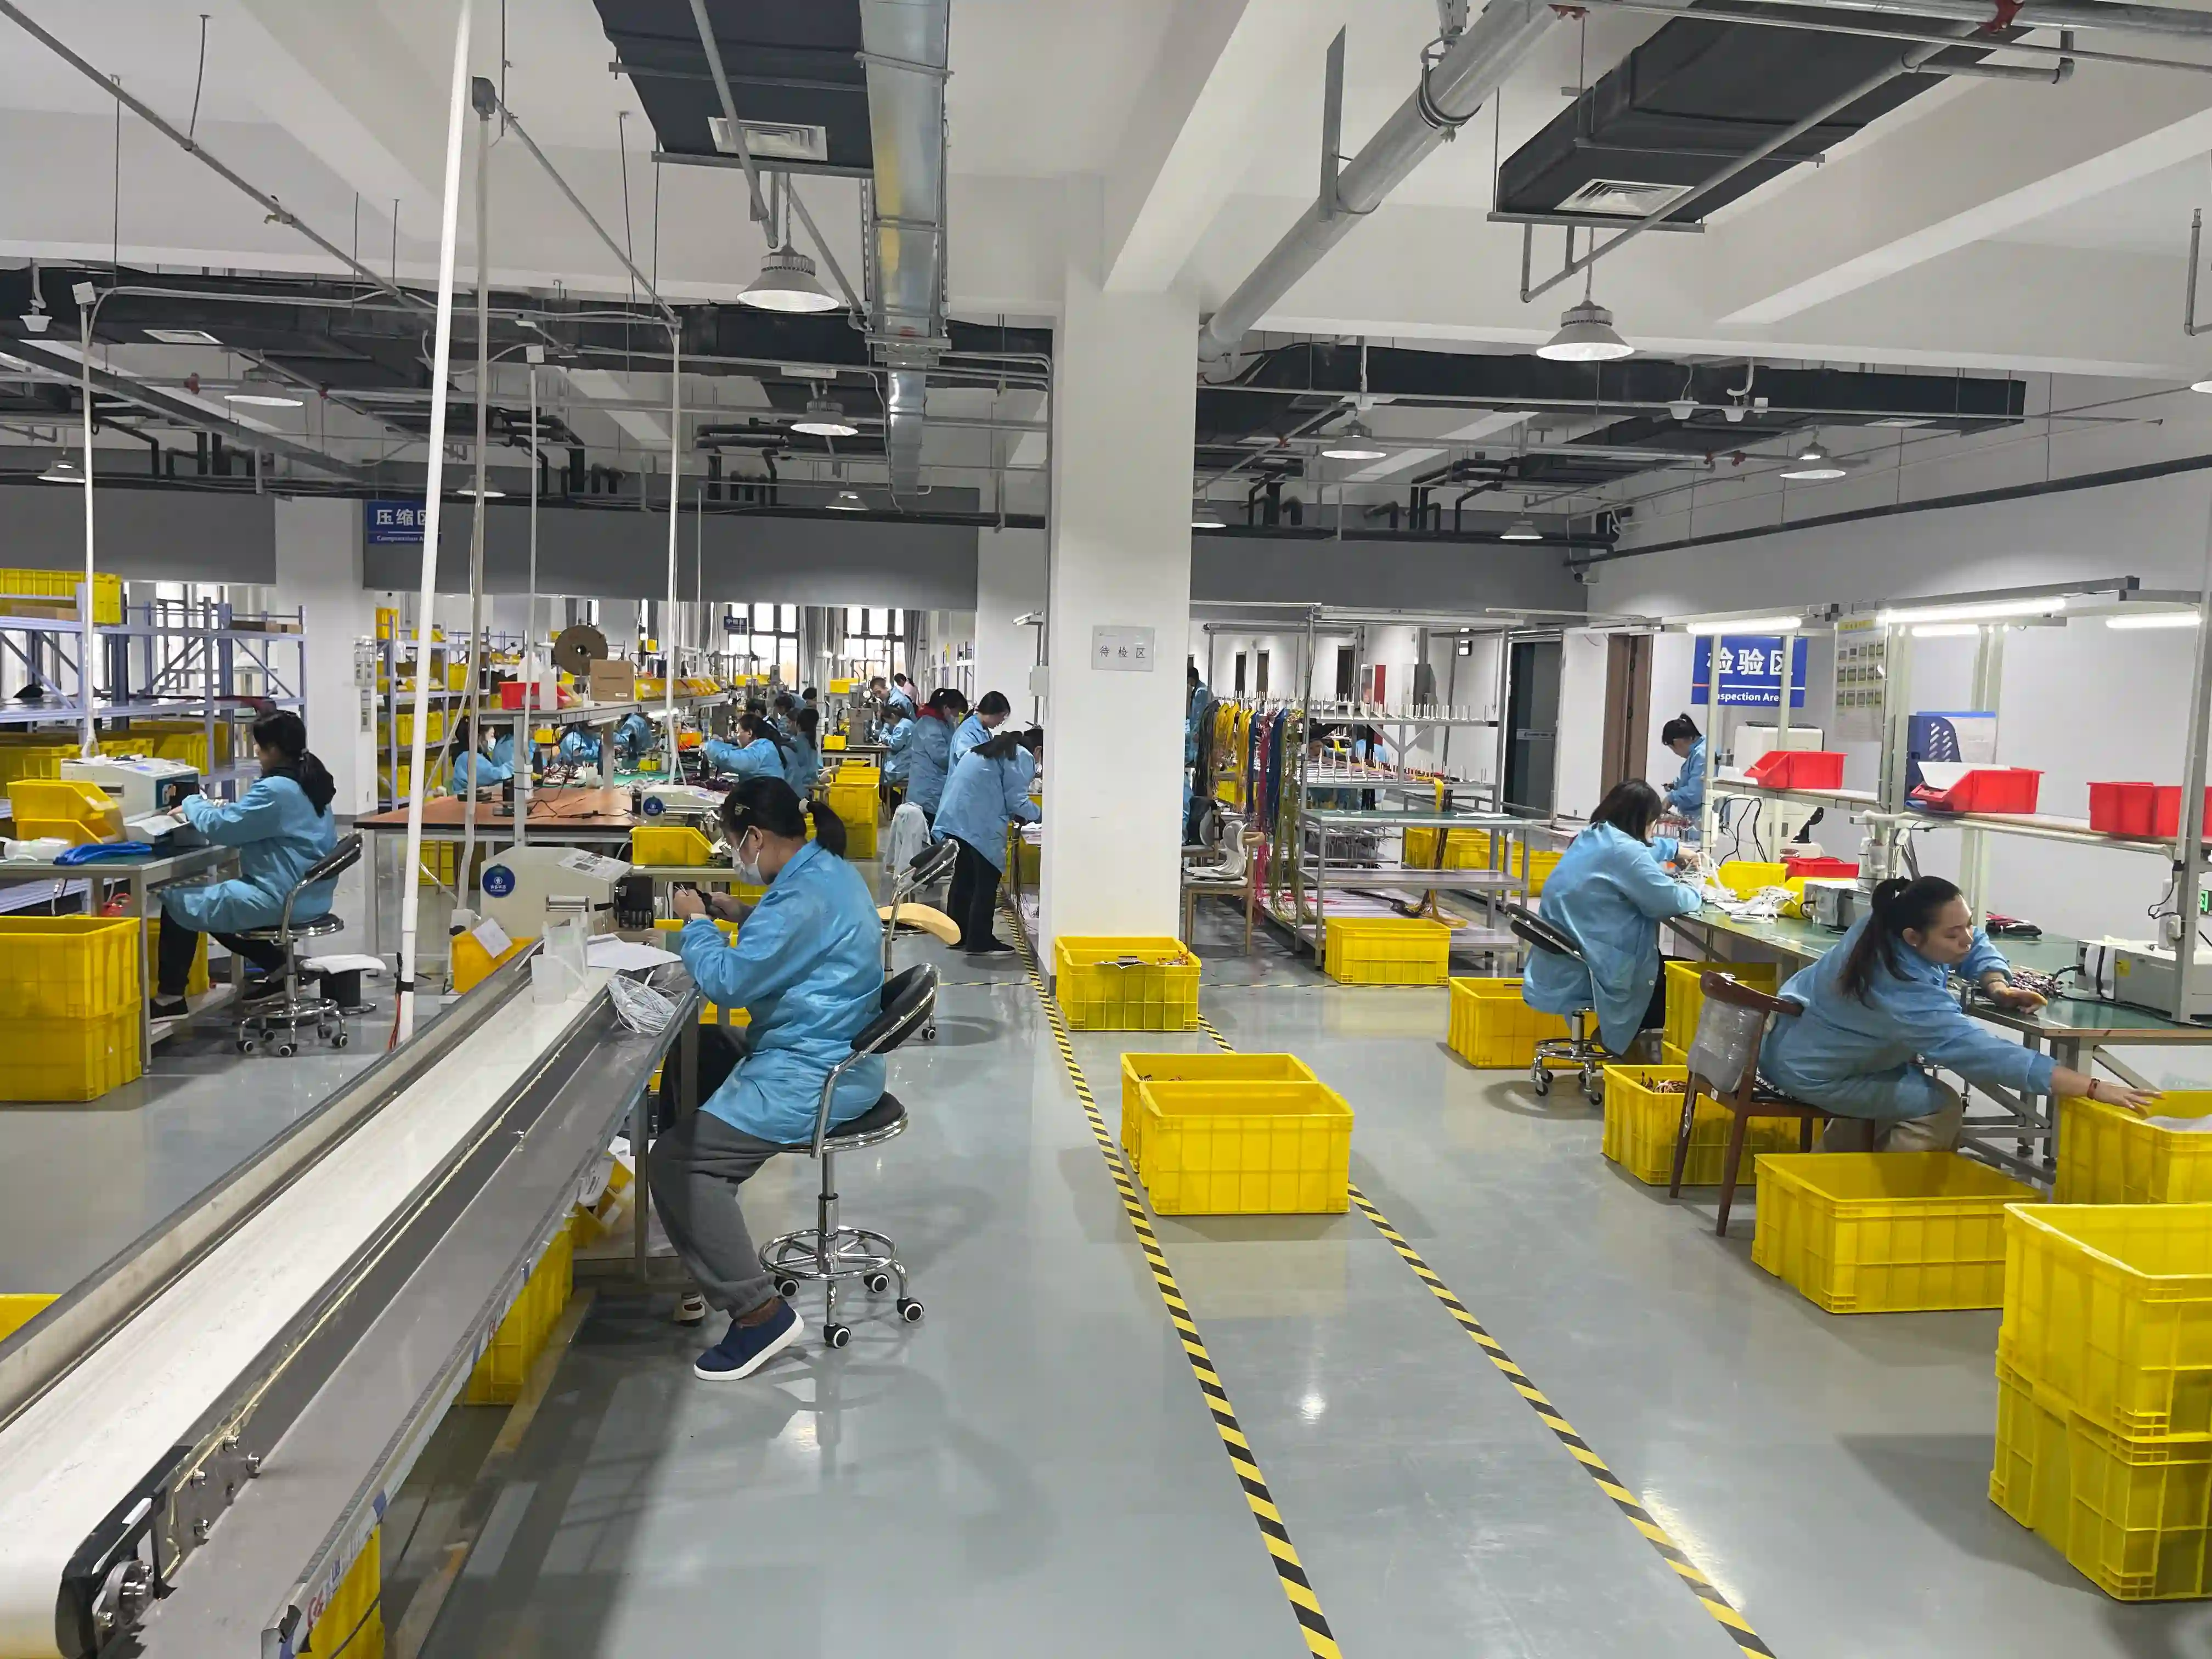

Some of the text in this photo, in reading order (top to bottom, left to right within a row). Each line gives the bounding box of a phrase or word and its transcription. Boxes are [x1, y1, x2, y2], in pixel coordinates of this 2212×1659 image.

[376, 509, 426, 526] 压缩区
[1099, 646, 1146, 658] 待检区
[1763, 693, 1780, 702] Are
